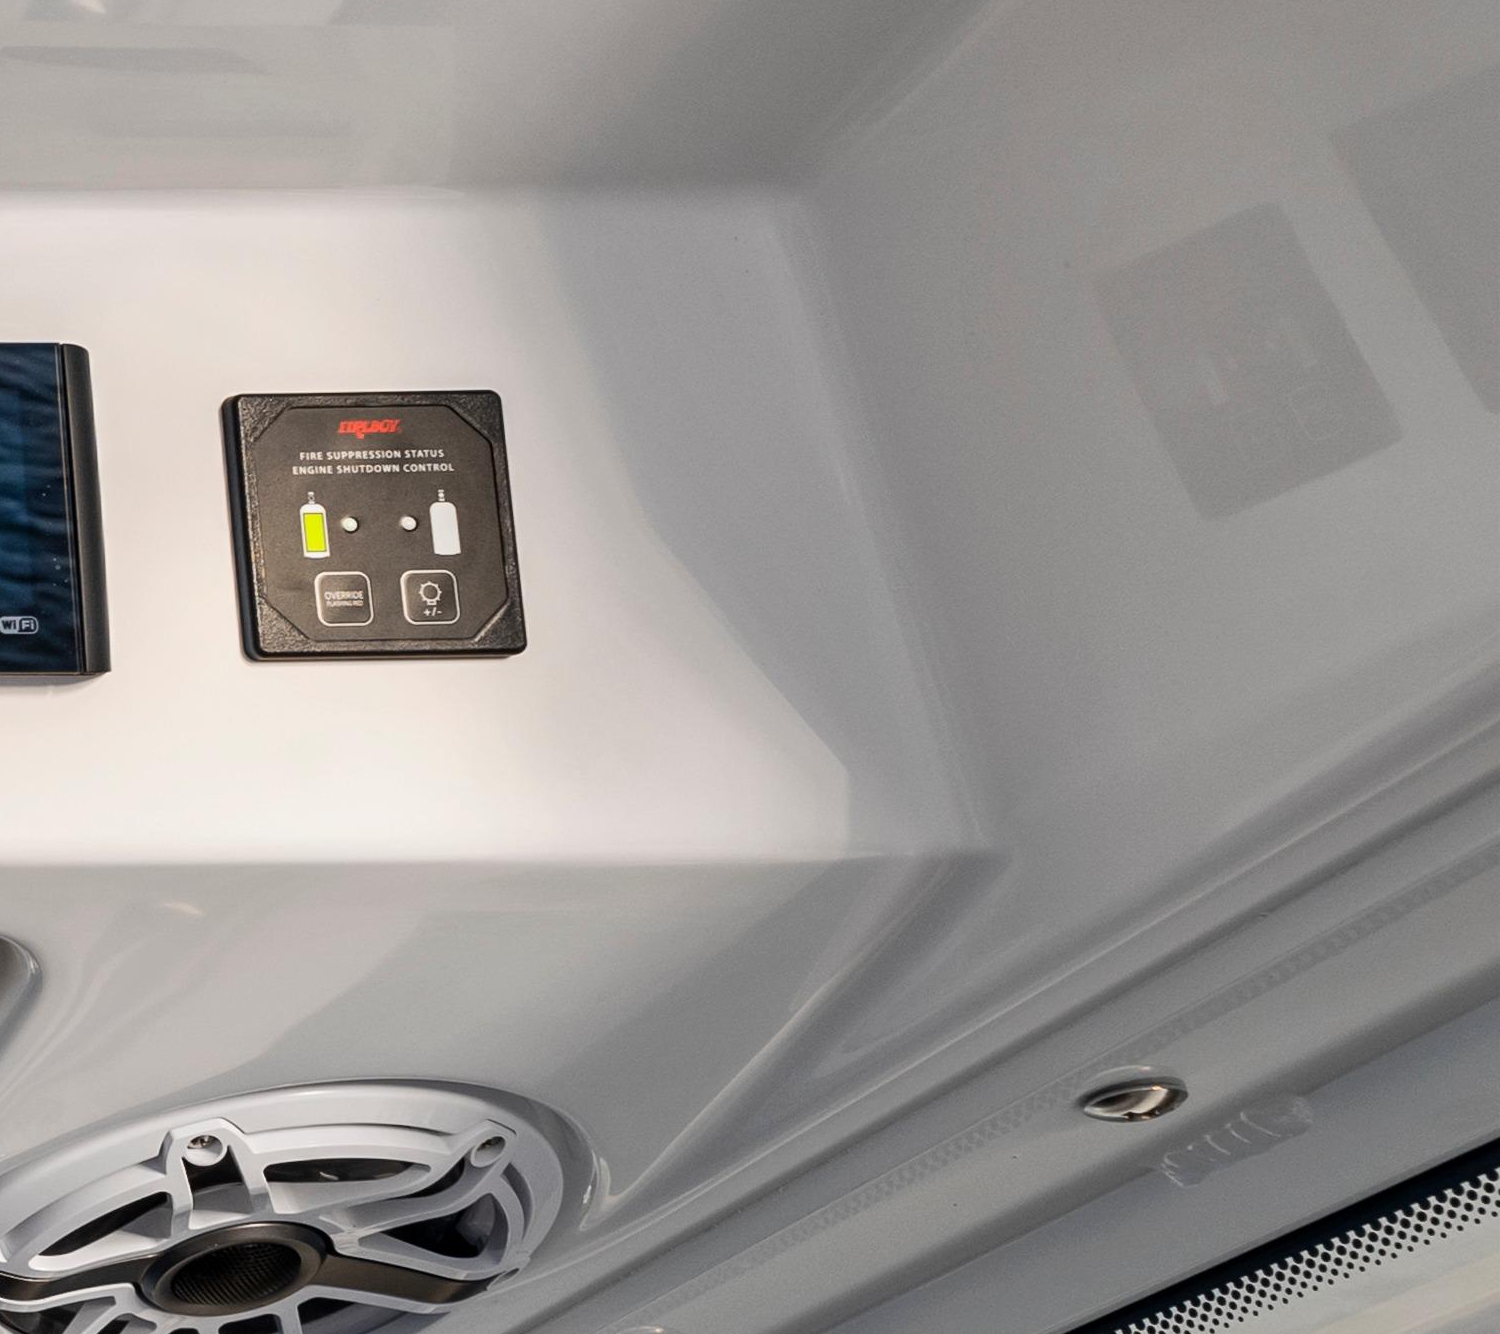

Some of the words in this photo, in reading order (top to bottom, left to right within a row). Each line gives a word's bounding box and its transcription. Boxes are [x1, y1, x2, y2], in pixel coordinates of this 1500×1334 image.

[300, 451, 323, 460] FIRE
[326, 450, 402, 460] SUPPRESSION
[405, 449, 445, 459] STATUS
[293, 466, 333, 475] ENGINE
[336, 464, 400, 474] SHUTDOWN
[403, 463, 454, 472] CONTROL
